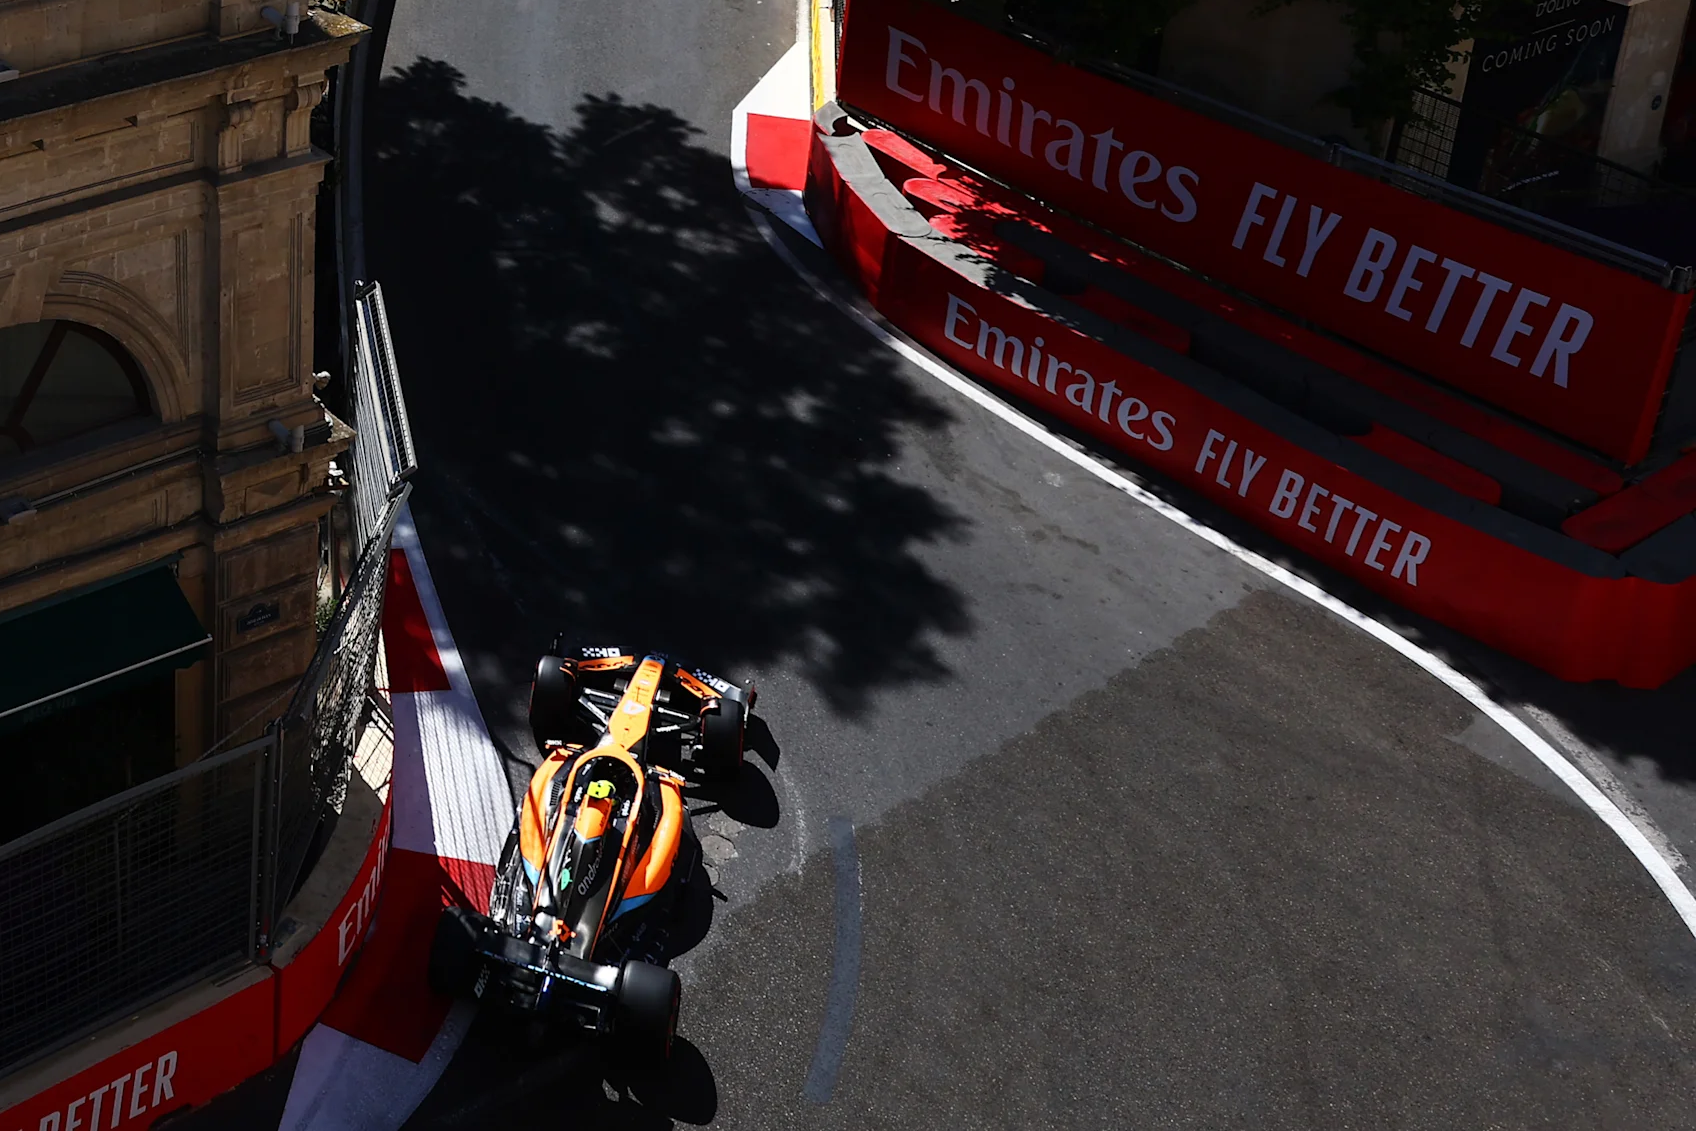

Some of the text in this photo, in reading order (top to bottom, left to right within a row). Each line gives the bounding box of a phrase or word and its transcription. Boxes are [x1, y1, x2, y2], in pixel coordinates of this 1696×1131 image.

[1482, 14, 1616, 72] COMING SOON
[886, 25, 1594, 388] Emirates FLY BETTER
[944, 292, 1431, 587] Emirates FLY BETTER
